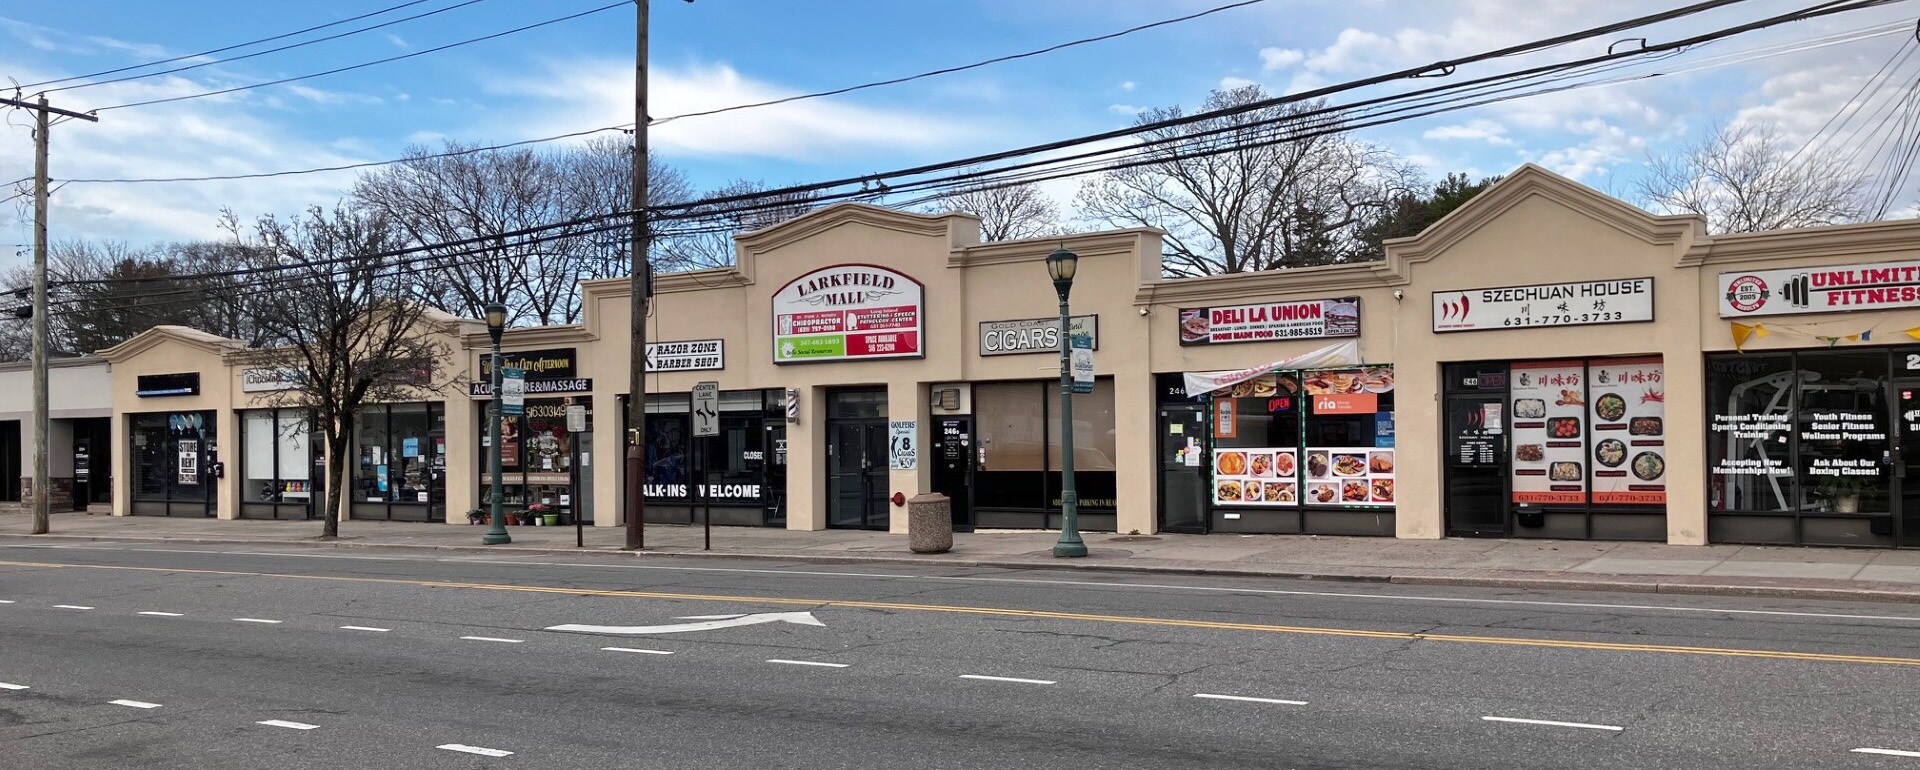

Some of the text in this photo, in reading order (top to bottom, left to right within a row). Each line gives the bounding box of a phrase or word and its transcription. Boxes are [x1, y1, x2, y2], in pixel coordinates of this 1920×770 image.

[1811, 266, 1920, 286] UNLIMIT
[797, 272, 896, 297] LARKFIELD
[1482, 280, 1645, 303] SZECHUAN HOUSE
[1827, 287, 1920, 306] FITNES
[824, 291, 865, 306] MALL
[1212, 303, 1321, 325] DELI LA UNION
[1503, 311, 1623, 326] 631-770-3733
[792, 318, 841, 327] CHIROPRACTOR
[991, 322, 1016, 330] GOLD
[984, 326, 1059, 352] CIGARS
[1212, 327, 1323, 340] HOME MADE FOOD 631-985-8519
[657, 342, 718, 355] RAZOR ZONE
[656, 357, 719, 369] BARBER SHOP
[473, 380, 587, 395] ACURE&MASSAGE
[1169, 387, 1185, 395] 246
[1268, 398, 1290, 412] OPEN
[1318, 397, 1336, 410] ria
[1715, 413, 1788, 422] Personal Training
[1813, 413, 1872, 421] Youth Fitness
[891, 421, 915, 429] GOLFERS
[1711, 423, 1791, 432] Sports Conditioning
[1811, 422, 1875, 430] Senior Fitness
[1733, 431, 1769, 440] Training
[1802, 432, 1886, 441] Wellness Programs
[179, 442, 197, 452] STORE
[902, 437, 911, 450] 8
[1721, 459, 1762, 467] Accepting
[1832, 459, 1858, 467] About
[1713, 466, 1767, 475] Memberships
[1809, 467, 1880, 476] Boxing Classes!
[643, 484, 687, 497] ALK-INS
